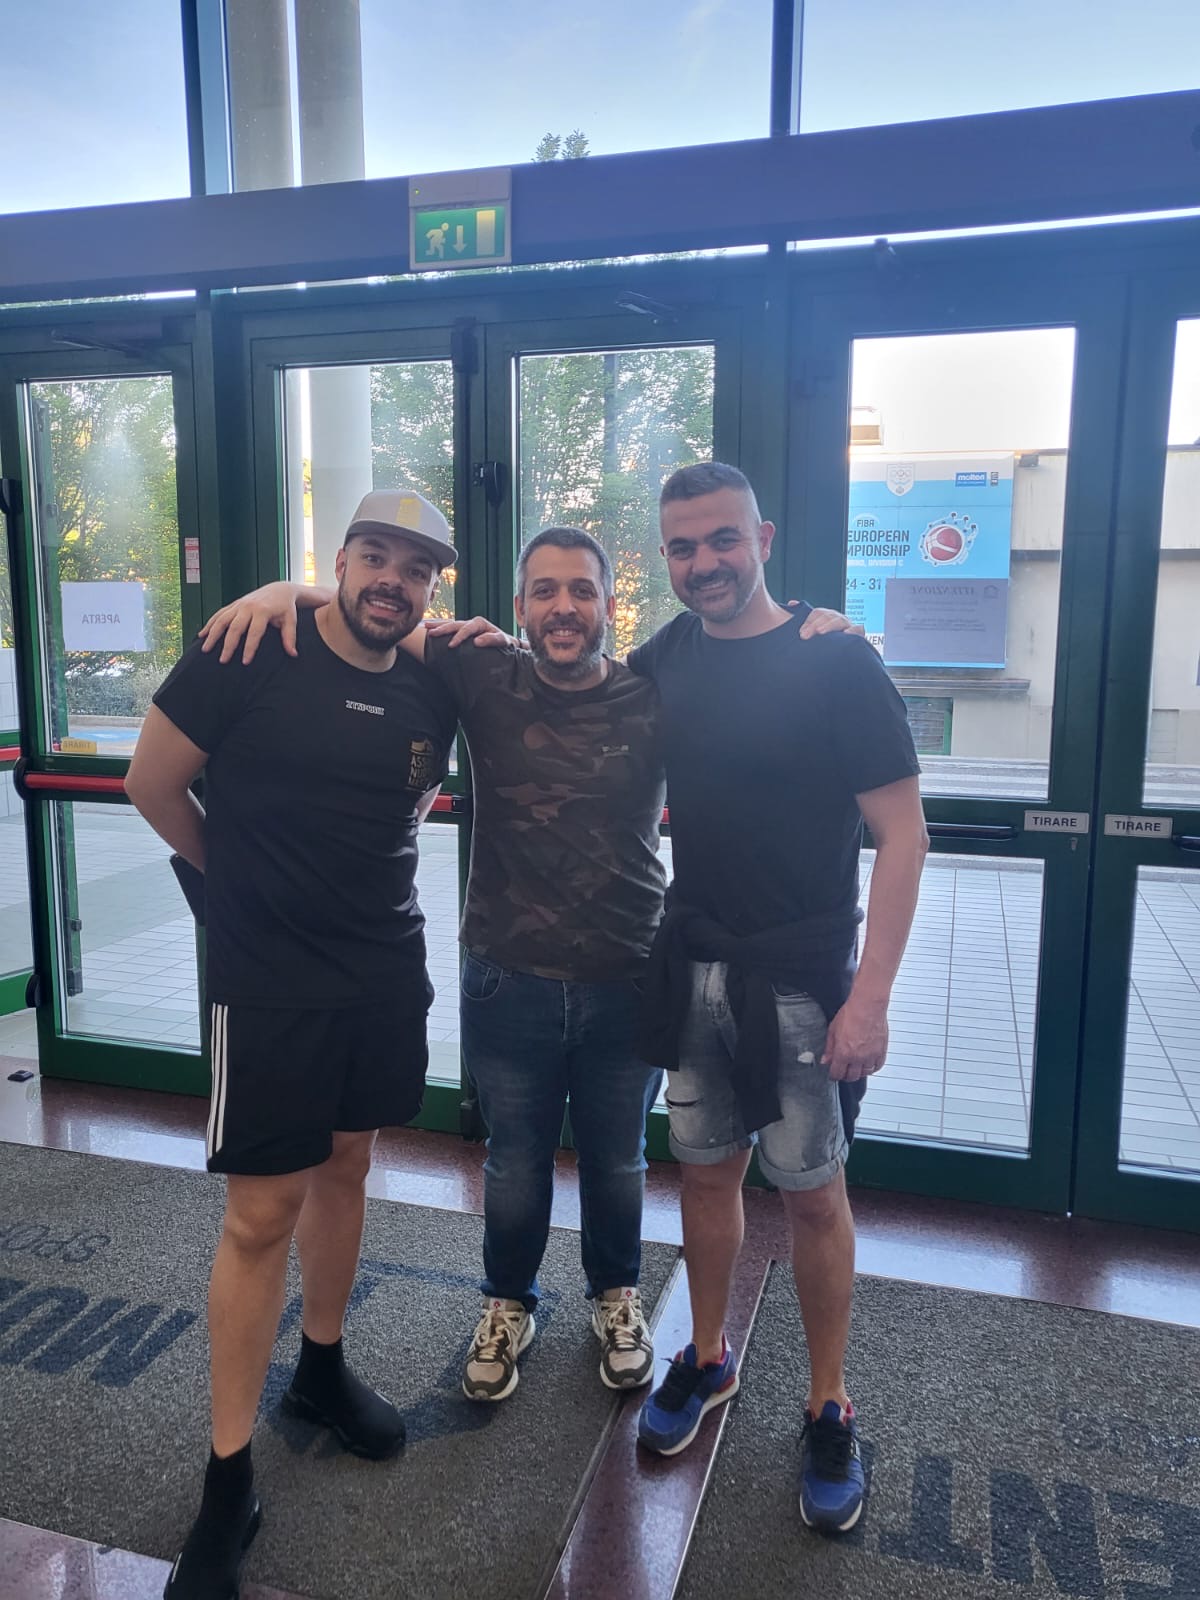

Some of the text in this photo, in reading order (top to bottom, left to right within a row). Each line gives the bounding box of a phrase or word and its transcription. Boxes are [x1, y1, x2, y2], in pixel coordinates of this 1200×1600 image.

[957, 473, 985, 481] molten
[856, 519, 875, 527] FIBA
[847, 530, 910, 542] EUROPEAN
[868, 578, 881, 590] 31
[1032, 816, 1077, 827] TIRARE
[1114, 820, 1161, 832] TIRARE
